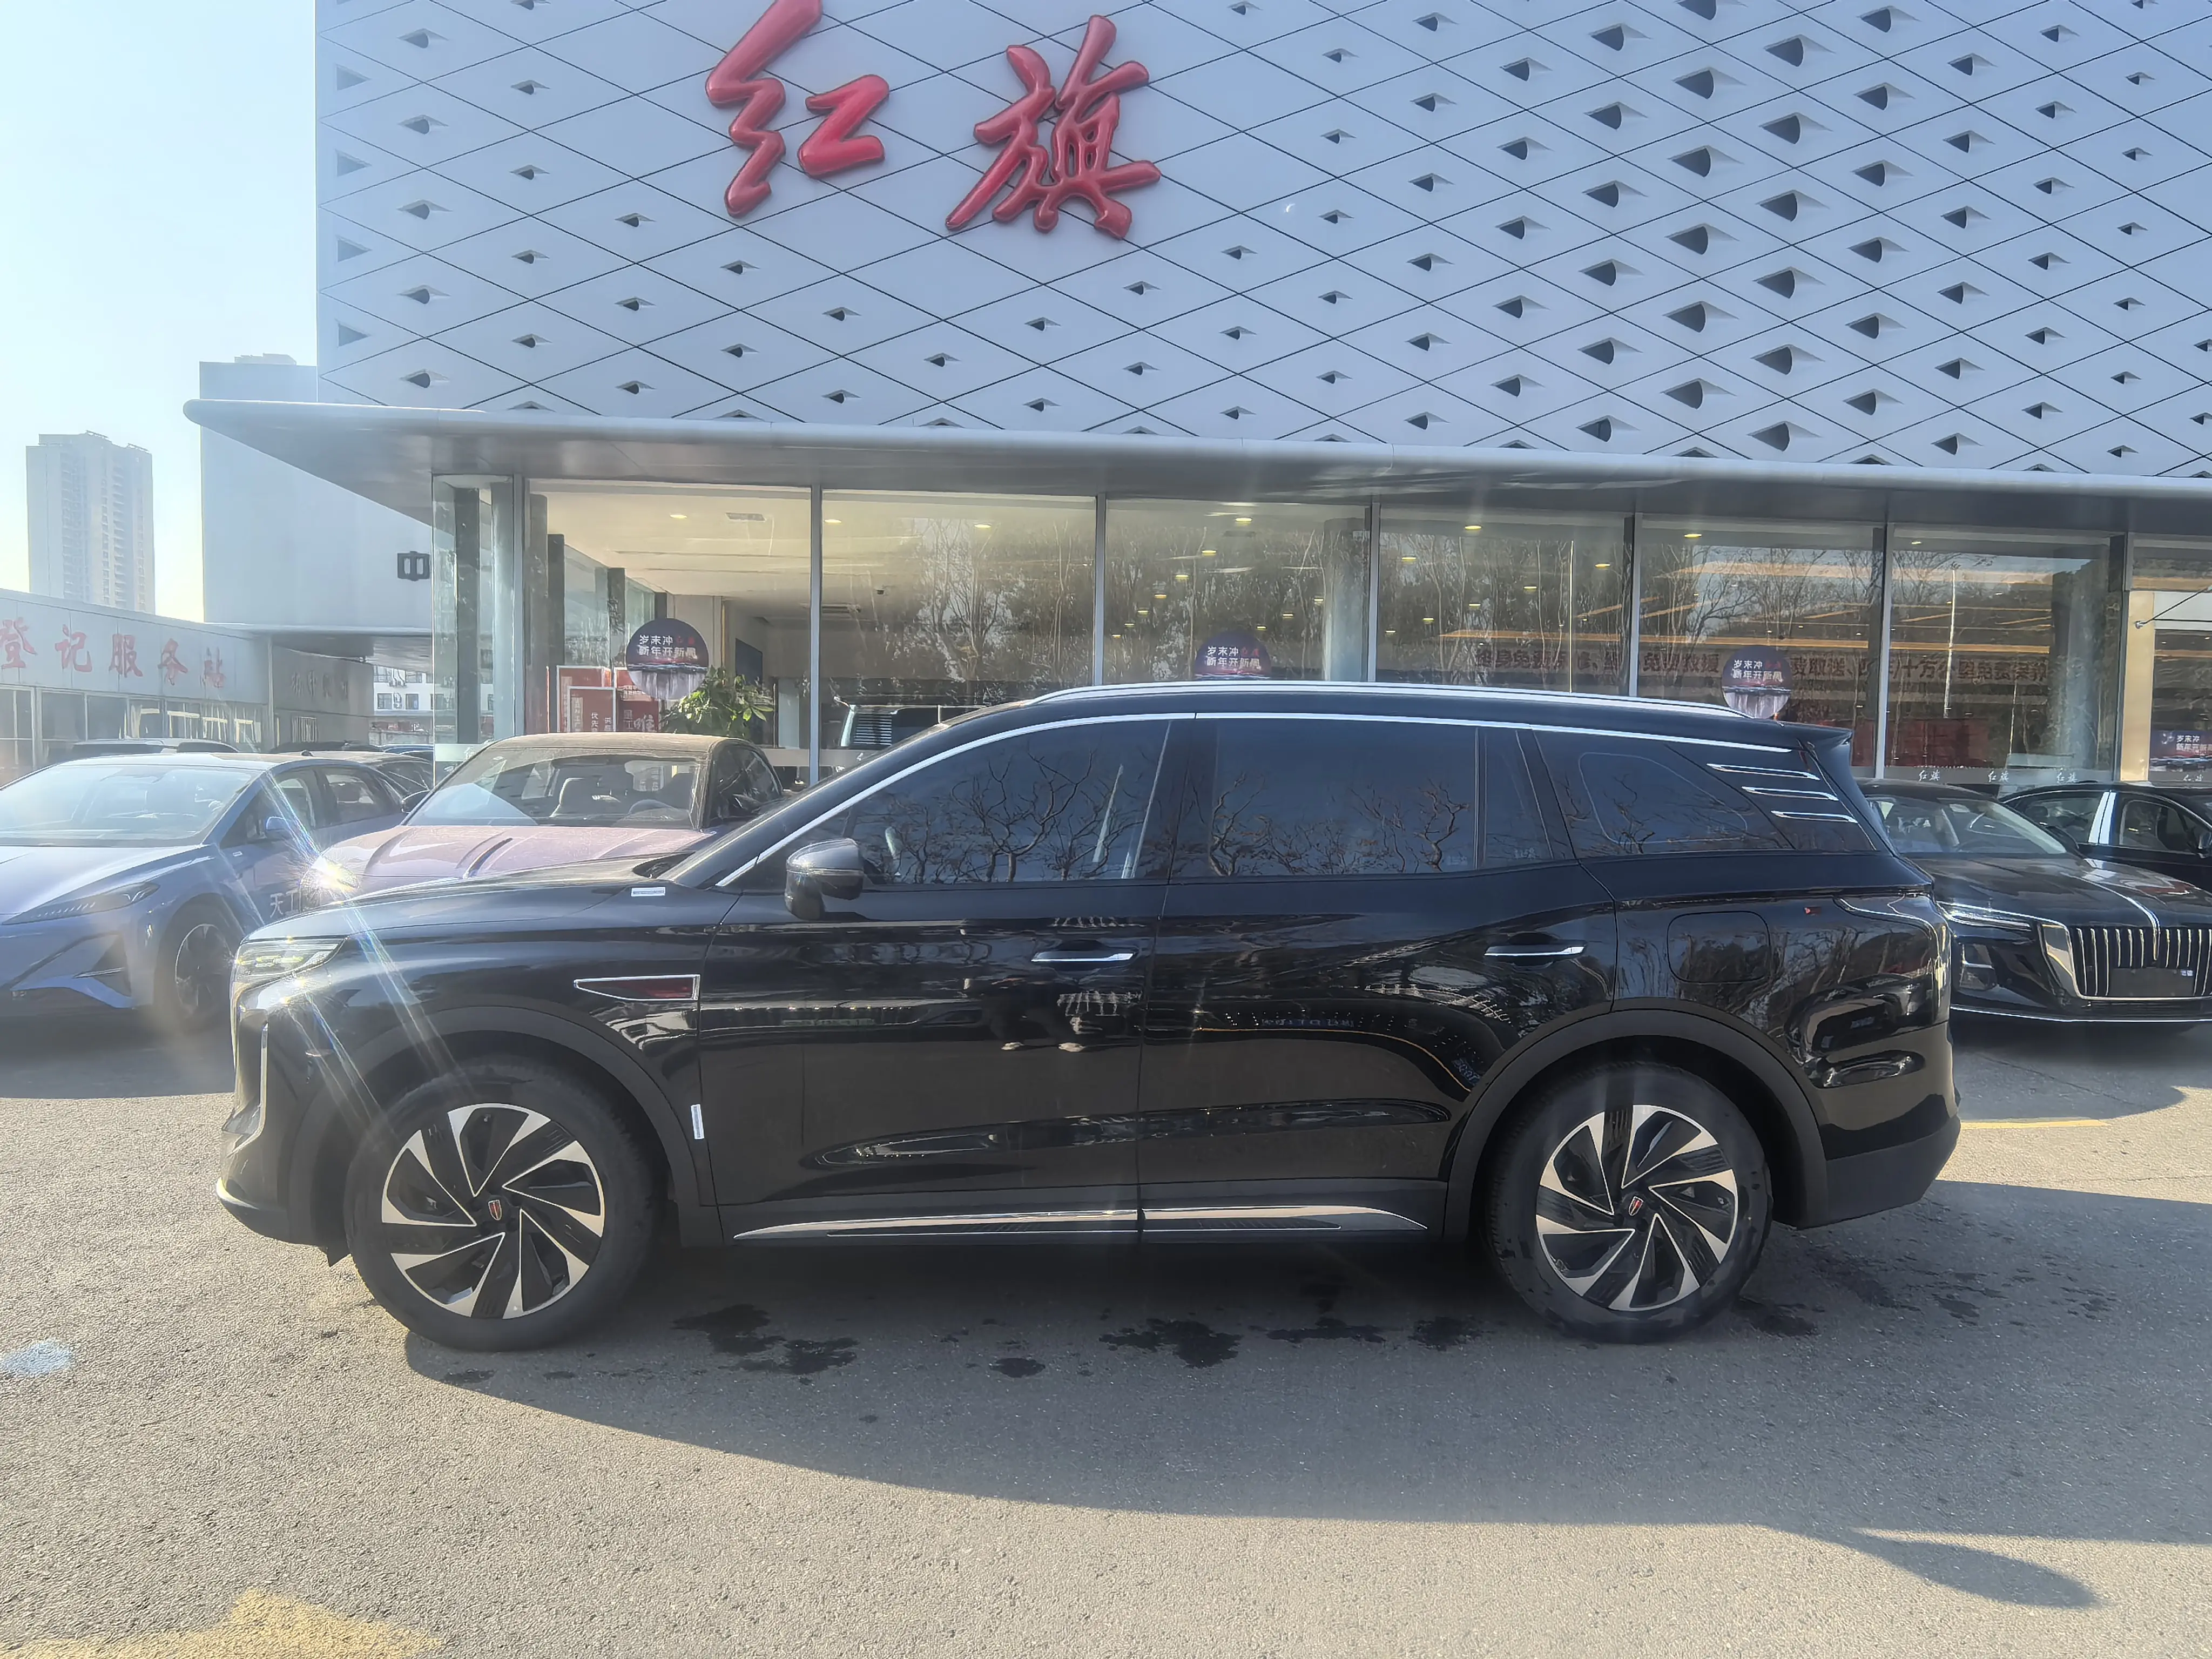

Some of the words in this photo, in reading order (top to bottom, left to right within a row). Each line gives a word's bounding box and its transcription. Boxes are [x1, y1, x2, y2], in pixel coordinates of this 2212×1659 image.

[705, 0, 1161, 239] 红旗
[0, 617, 226, 689] 登记服务站
